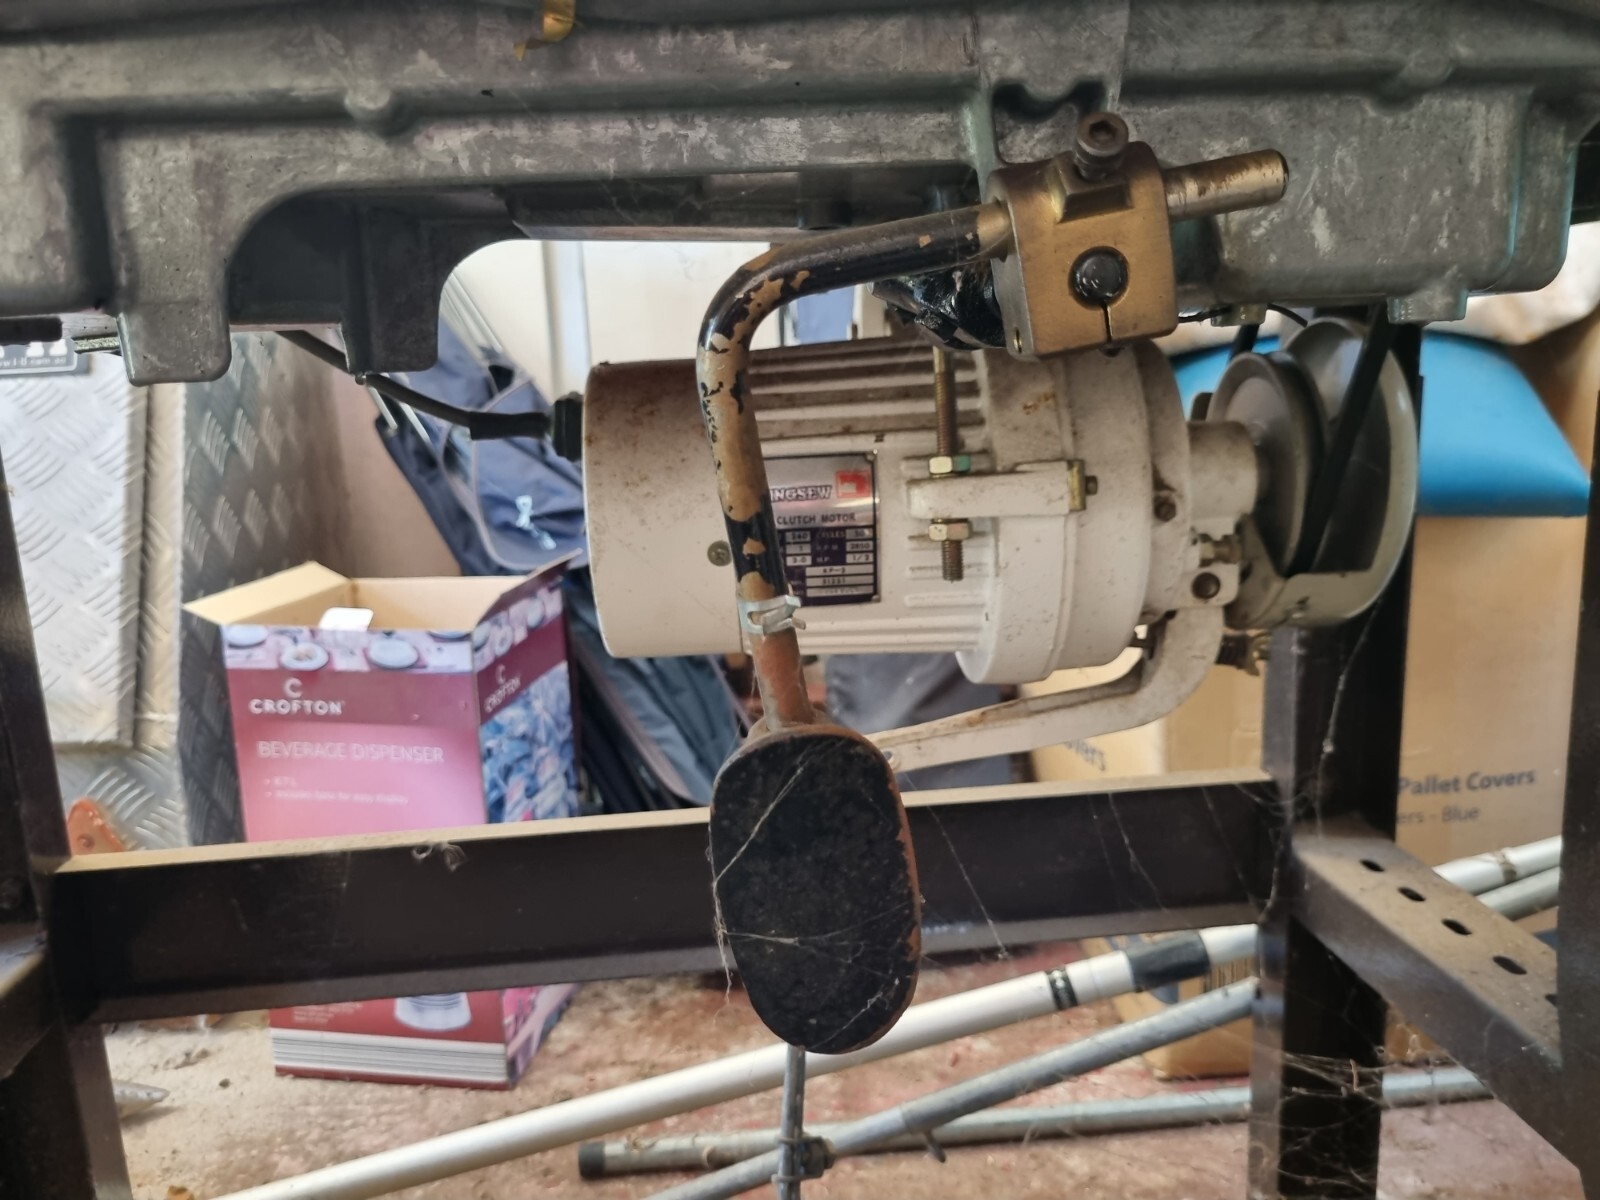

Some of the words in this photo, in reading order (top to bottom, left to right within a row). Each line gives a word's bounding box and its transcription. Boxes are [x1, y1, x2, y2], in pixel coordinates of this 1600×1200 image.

[769, 485, 832, 502] INGSEW
[776, 514, 816, 525] CLUTCH
[821, 513, 856, 523] MOTOR
[248, 698, 343, 716] CROFTON
[256, 741, 347, 760] BEVERAGE
[351, 743, 445, 763] DISPENSER
[1398, 774, 1461, 796] Pallet
[1465, 769, 1536, 791] Covers
[1396, 810, 1425, 825] ers
[1441, 806, 1480, 823] Blue
